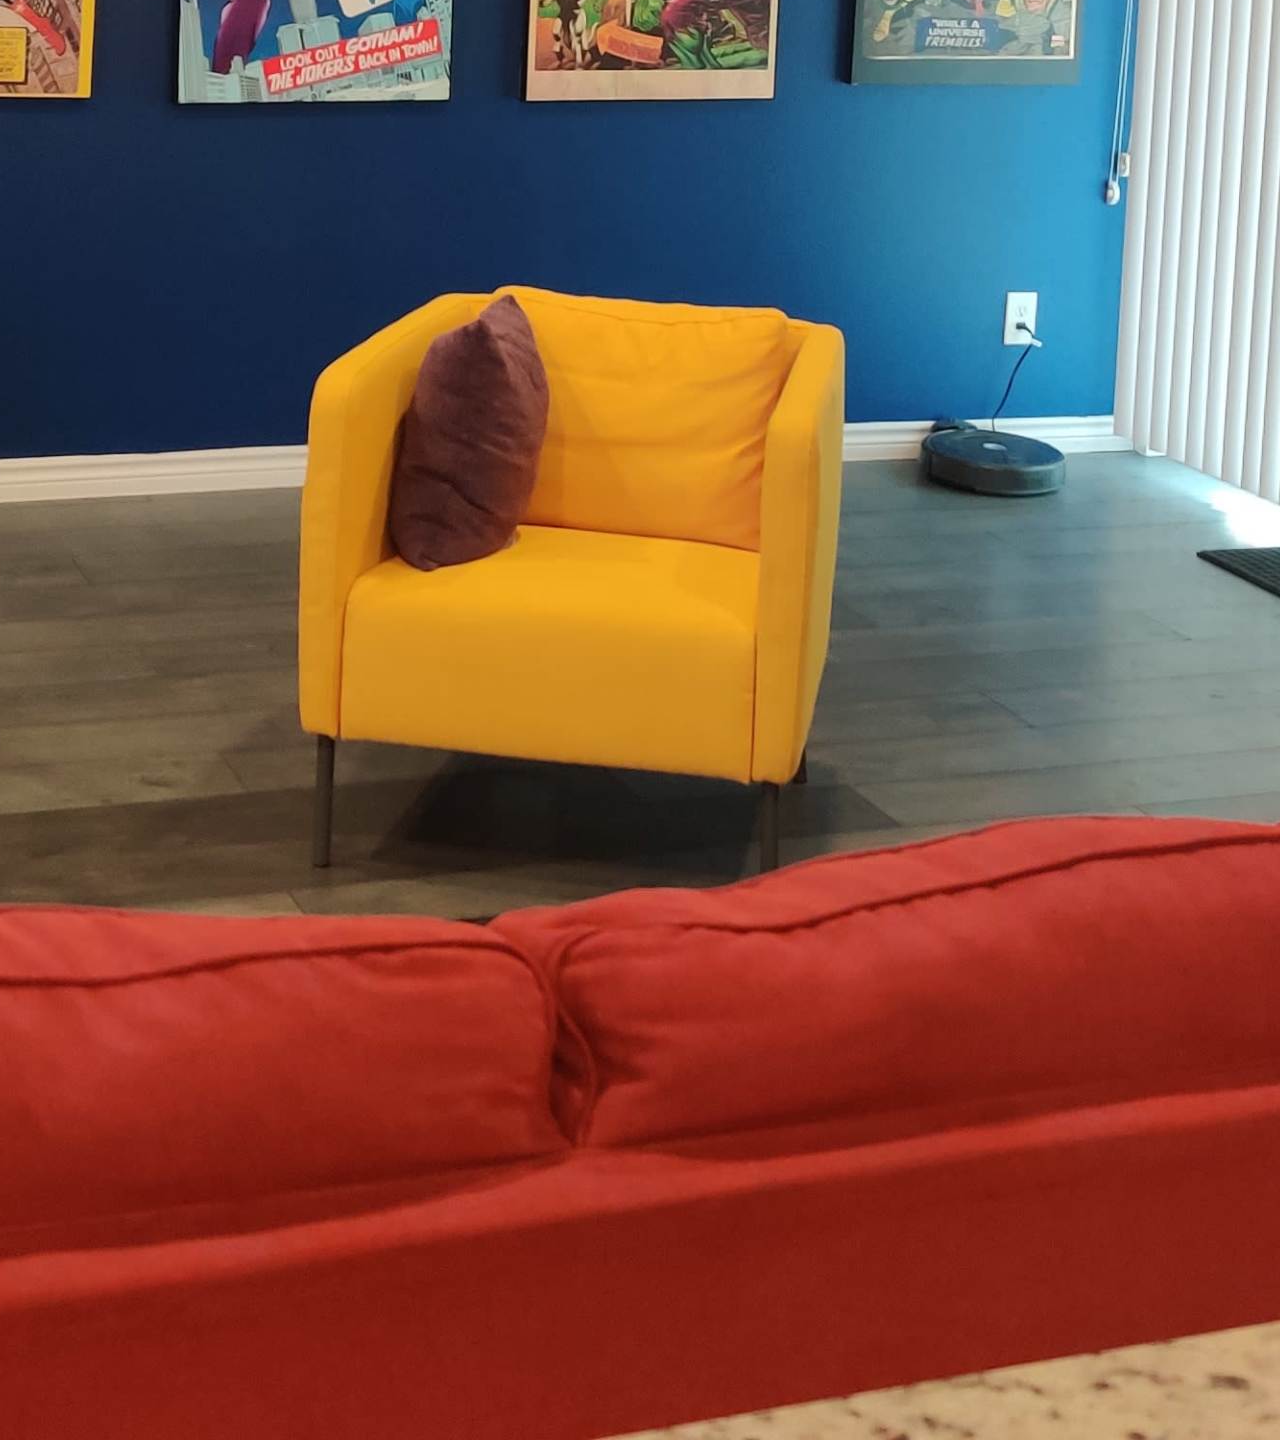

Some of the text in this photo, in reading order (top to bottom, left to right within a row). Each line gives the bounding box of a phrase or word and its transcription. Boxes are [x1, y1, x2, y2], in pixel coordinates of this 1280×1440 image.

[928, 27, 986, 37] UNIVERSE
[970, 20, 981, 28] A
[280, 51, 314, 71] LOOK
[345, 22, 424, 55] GOTHAM!
[268, 68, 295, 93] THE
[358, 50, 389, 70] BACK
[389, 48, 401, 63] IN
